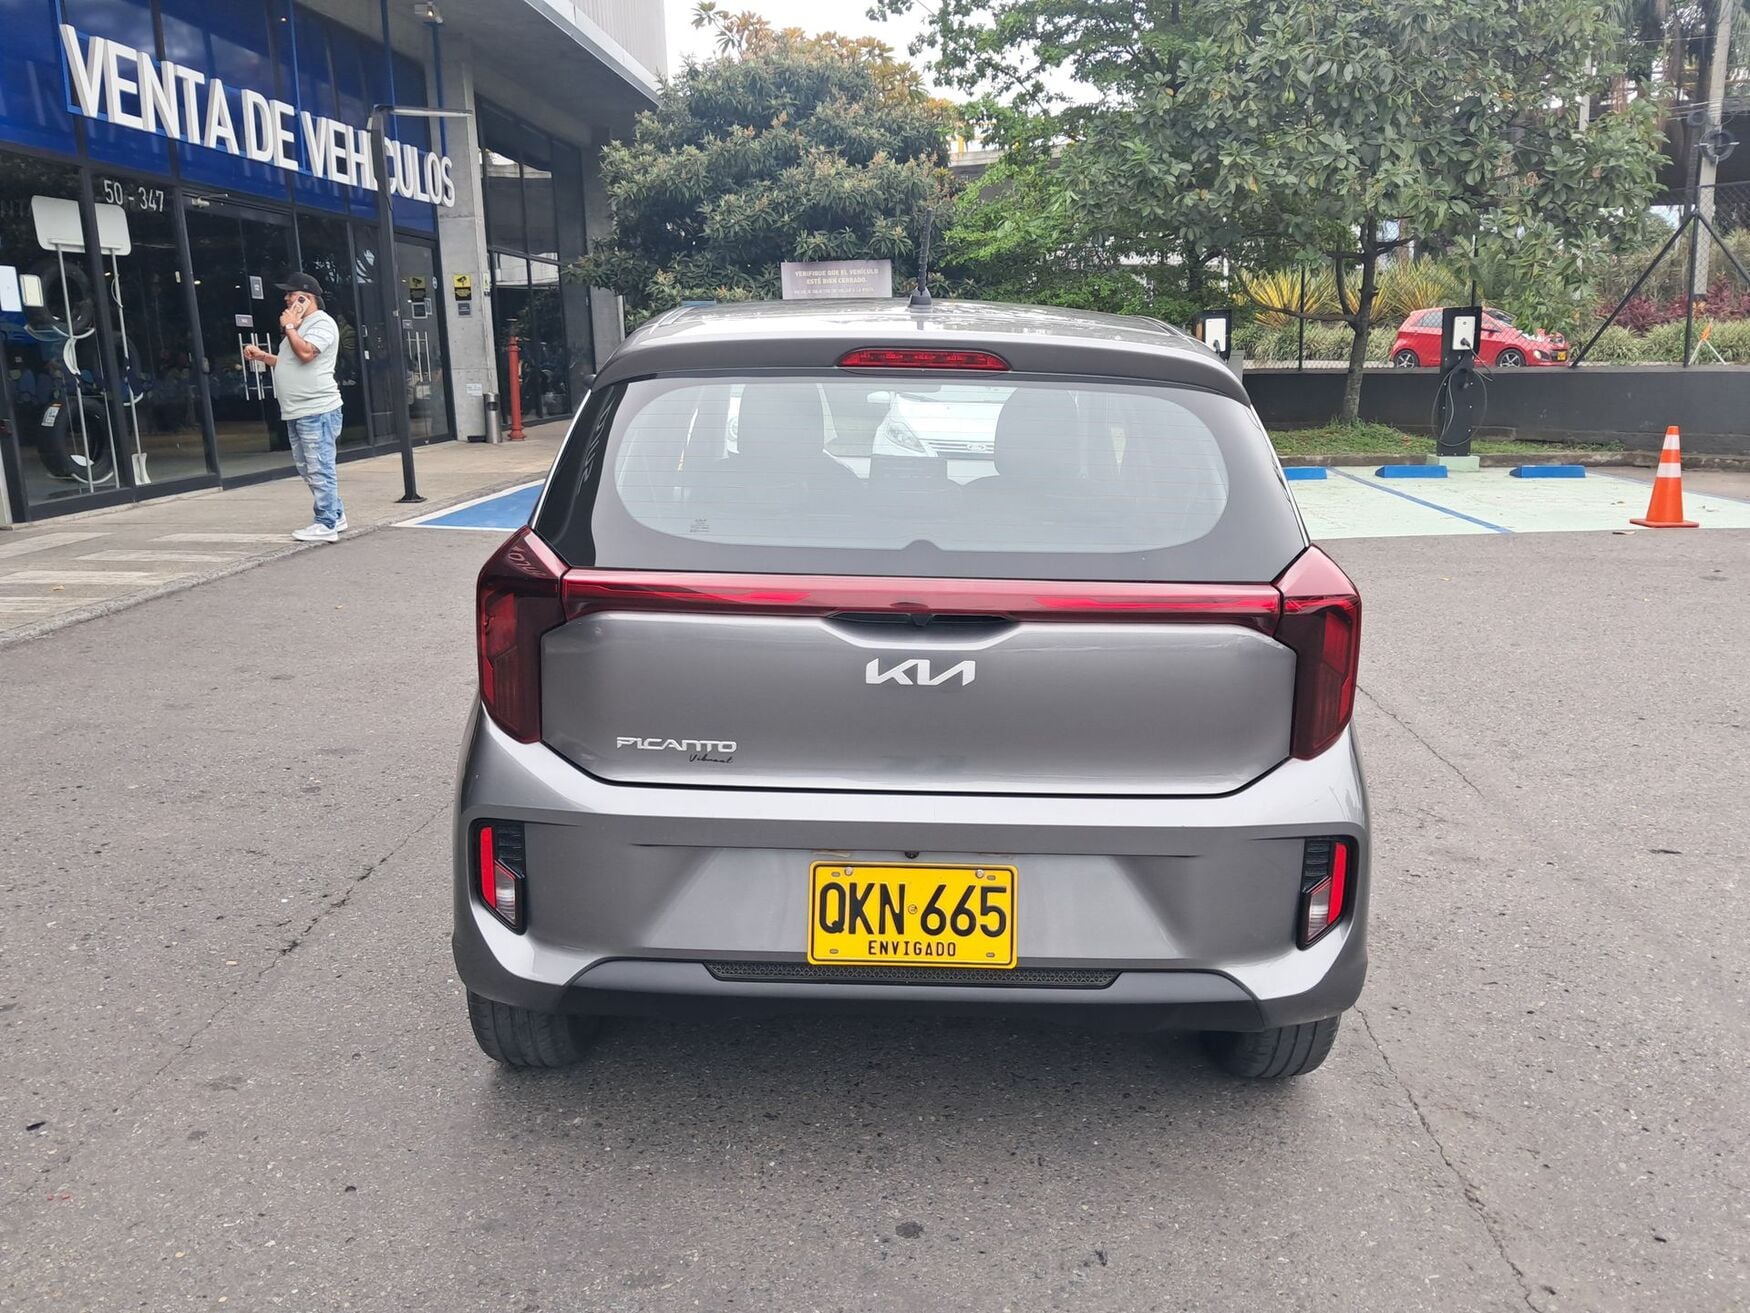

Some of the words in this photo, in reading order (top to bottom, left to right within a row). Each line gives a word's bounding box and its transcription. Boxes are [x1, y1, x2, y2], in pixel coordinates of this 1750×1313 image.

[59, 23, 240, 155] VENTA
[241, 88, 299, 171] DE
[103, 179, 124, 206] 50
[138, 186, 164, 213] 347
[827, 268, 840, 276] QUE
[866, 658, 976, 686] KIA
[616, 736, 737, 753] PICANTO
[819, 882, 906, 934] QKN
[920, 884, 1007, 938] 665
[868, 940, 956, 957] ENVIGADO
